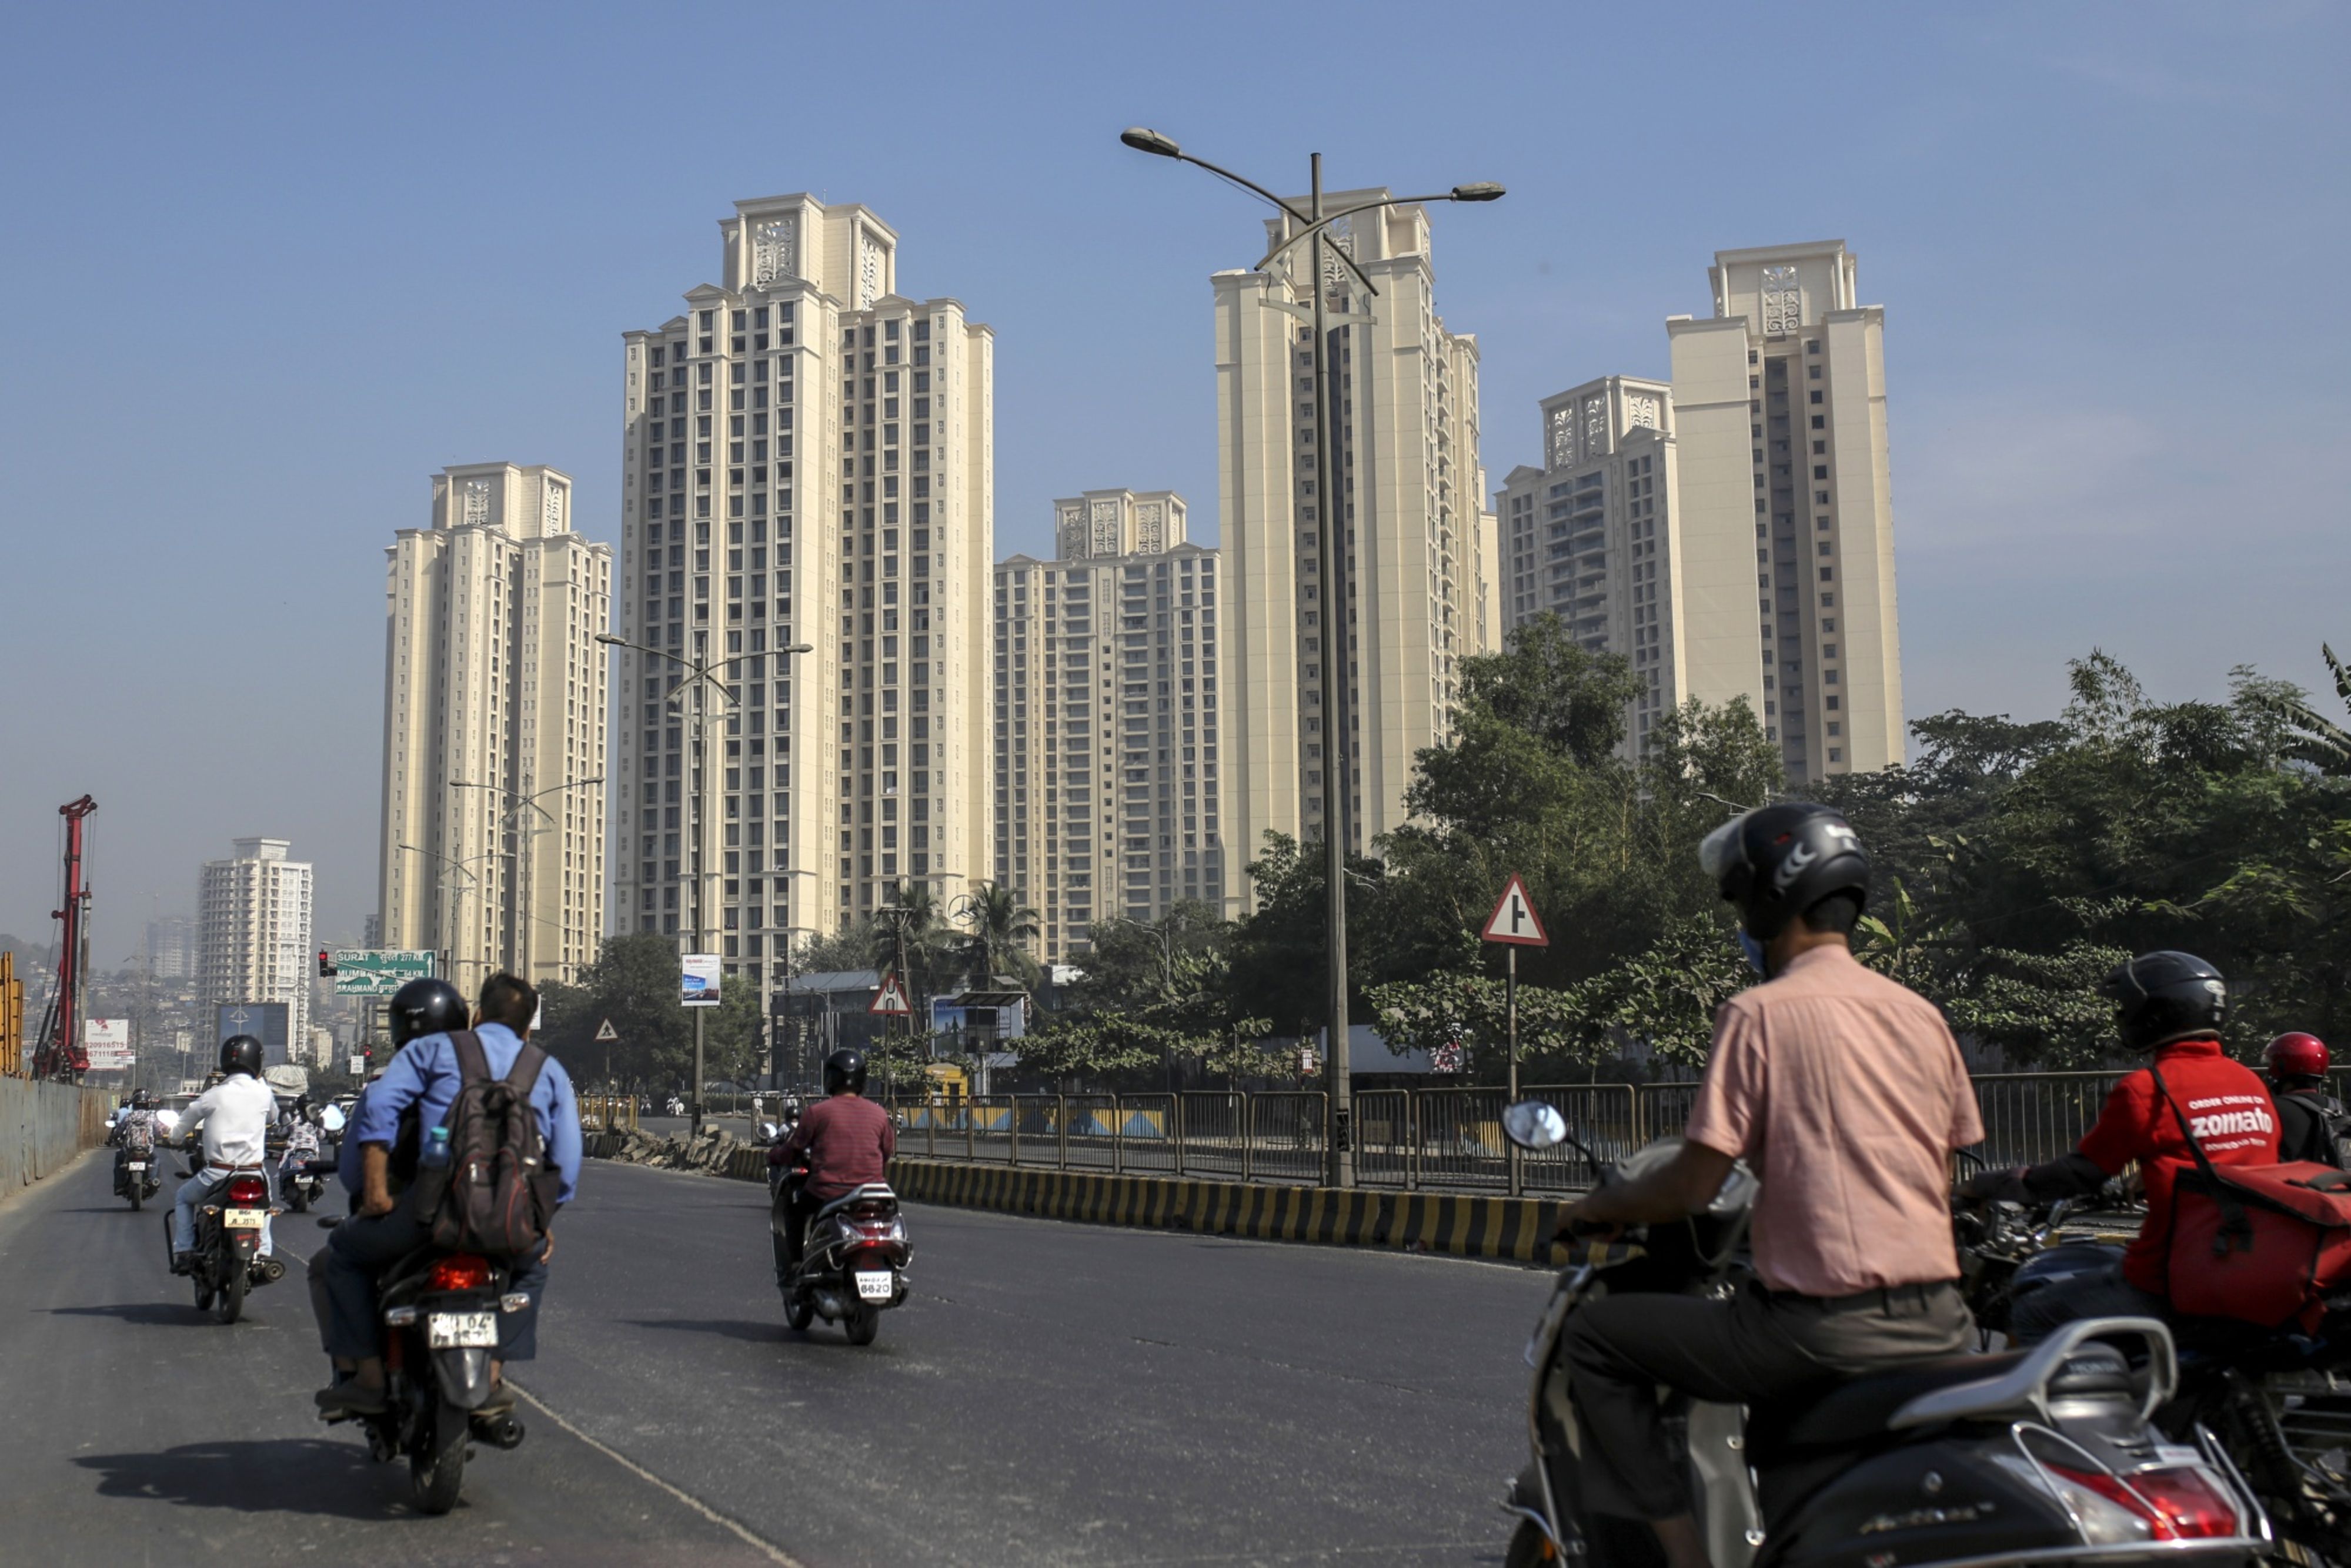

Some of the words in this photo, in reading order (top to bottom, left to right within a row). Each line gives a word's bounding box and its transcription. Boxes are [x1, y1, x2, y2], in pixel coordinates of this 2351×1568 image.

[336, 984, 378, 994] BRAHMAND
[2189, 1098, 2223, 1110] ORDER
[2222, 1095, 2254, 1105] ONLINE
[2190, 1107, 2273, 1138] zomato
